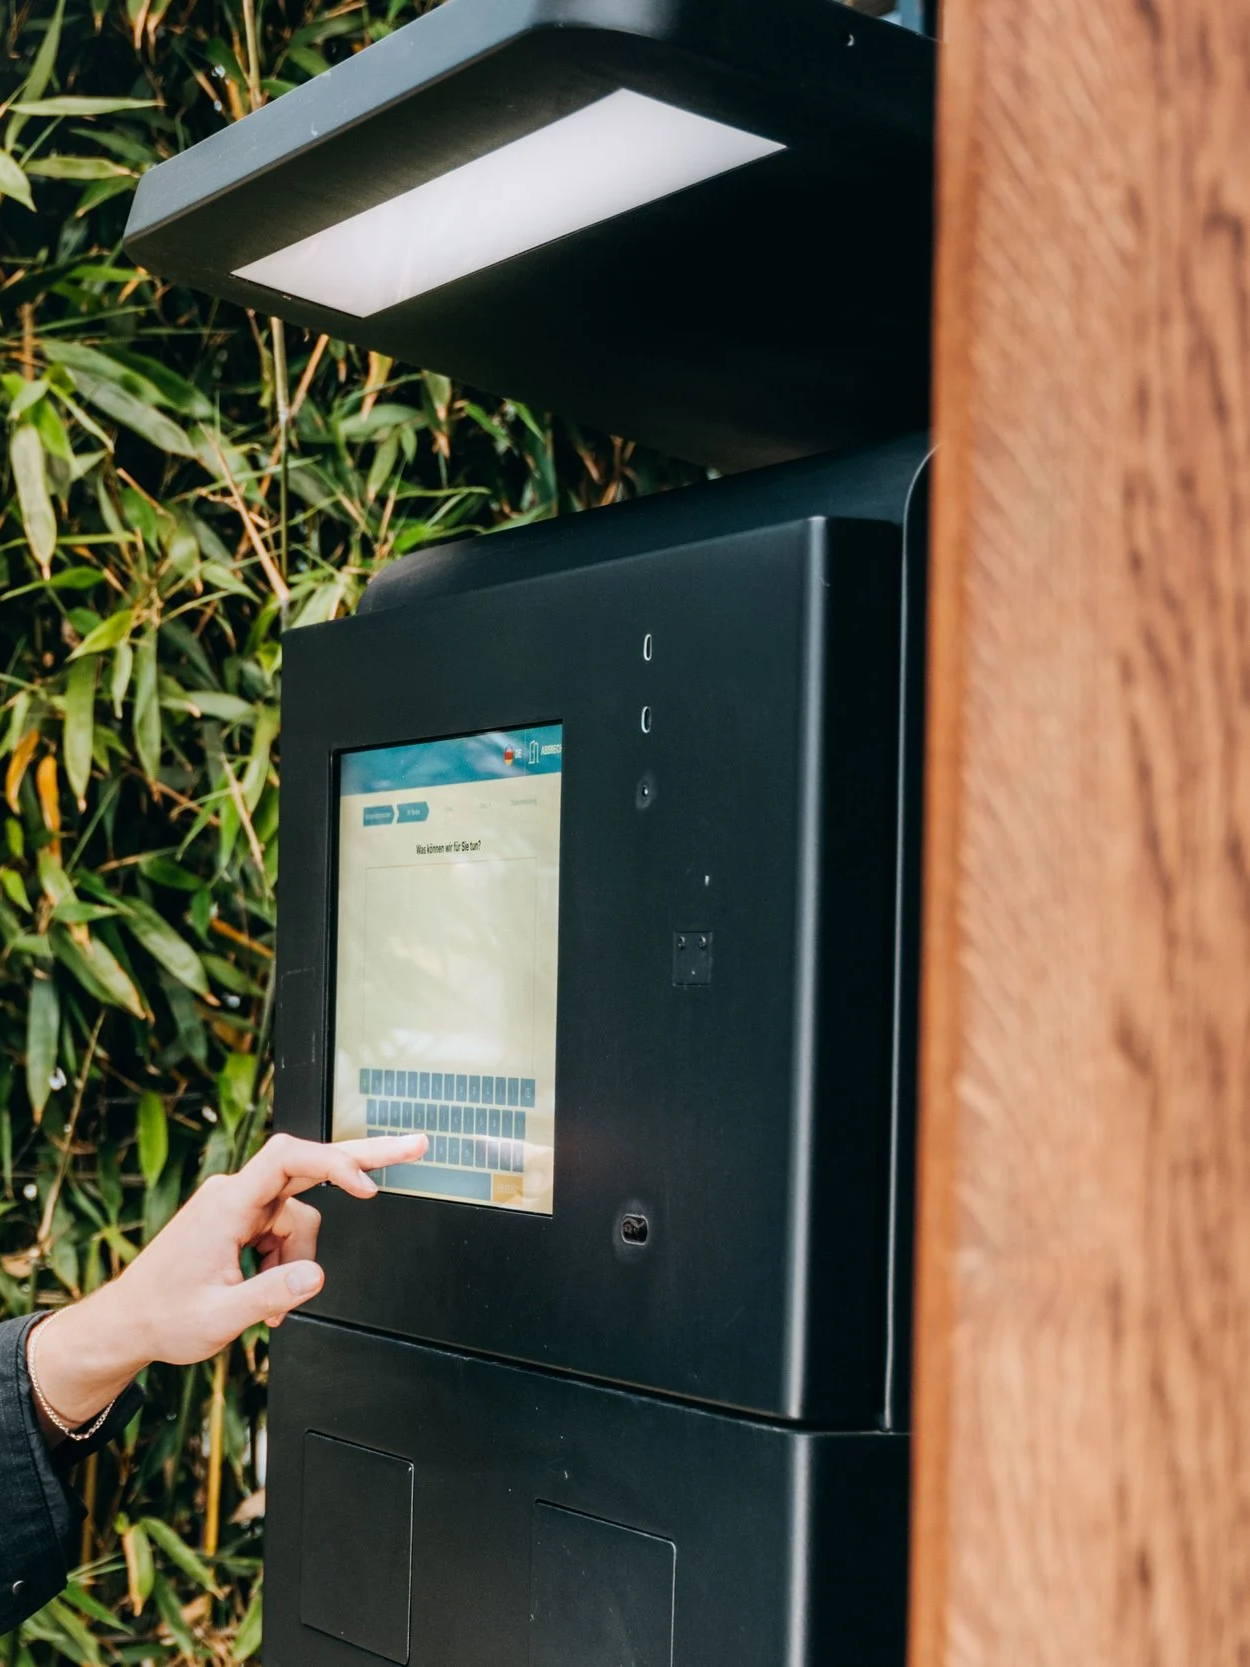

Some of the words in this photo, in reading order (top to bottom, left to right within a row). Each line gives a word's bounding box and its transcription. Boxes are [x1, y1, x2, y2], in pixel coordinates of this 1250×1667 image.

[416, 844, 426, 854] Was
[427, 843, 444, 853] können
[461, 841, 469, 851] Sie
[470, 840, 481, 851] tun?
